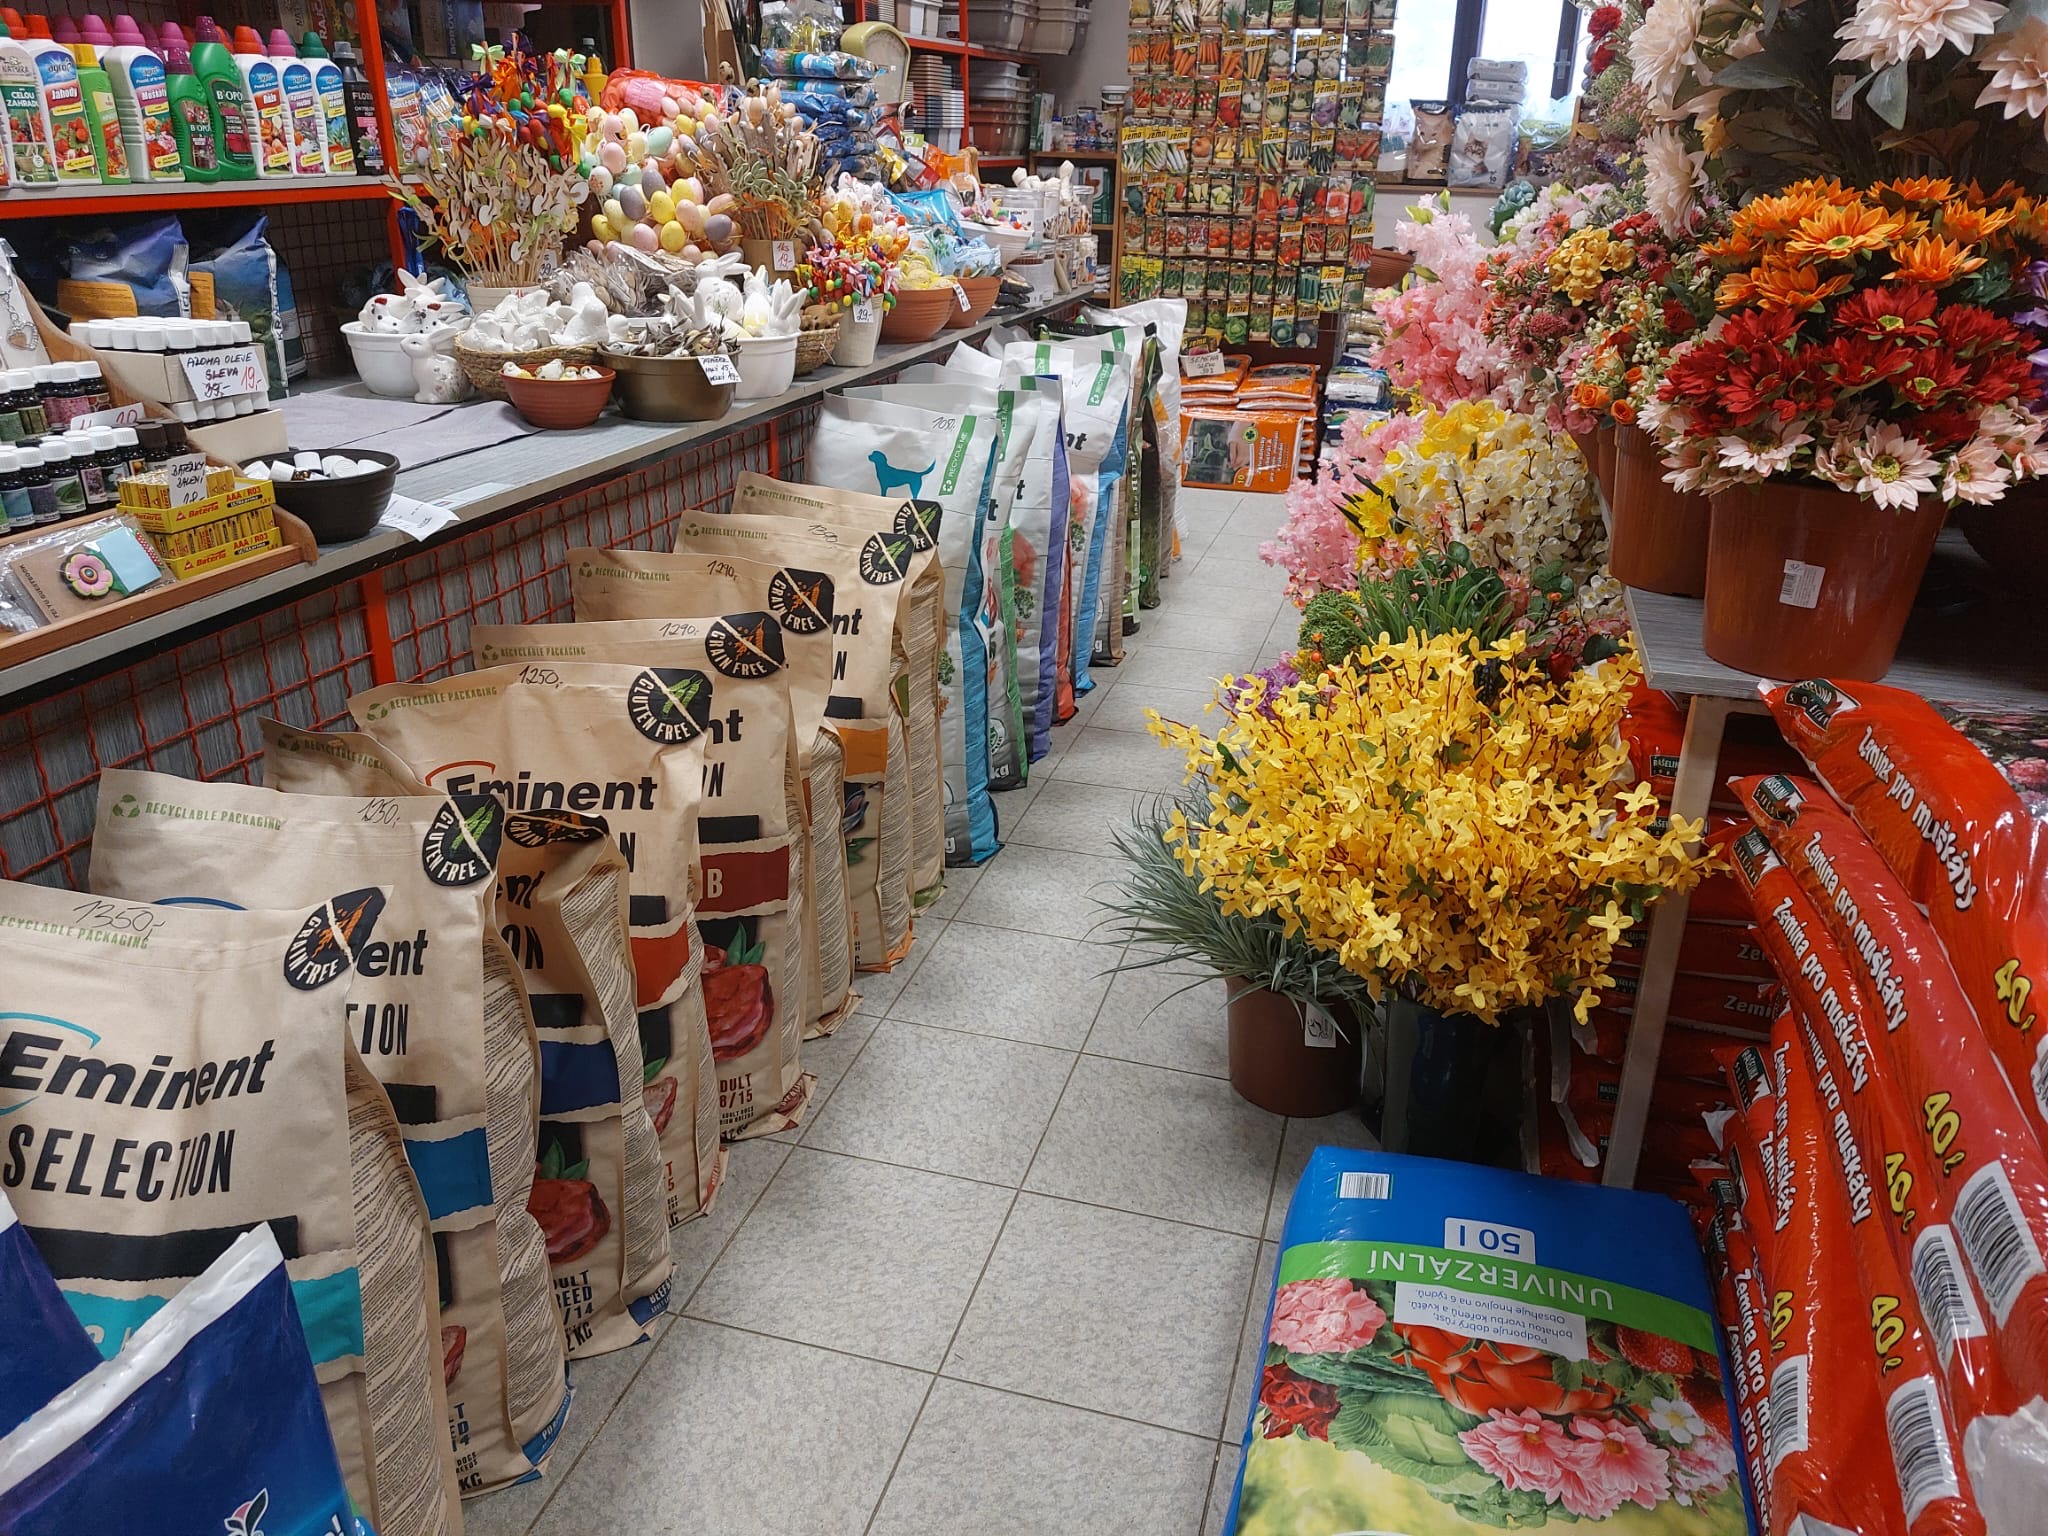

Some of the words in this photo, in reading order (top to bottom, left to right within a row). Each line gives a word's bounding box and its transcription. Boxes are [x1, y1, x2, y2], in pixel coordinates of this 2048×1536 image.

[205, 367, 239, 381] SLEVA
[226, 492, 242, 502] AAA
[247, 486, 261, 497] R03
[188, 502, 219, 518] Bateria
[233, 539, 249, 549] AAA
[862, 539, 880, 576] GLUTEN
[196, 550, 226, 567] Bateria
[870, 570, 894, 584] FREE
[769, 578, 787, 617] GRAIN
[785, 614, 816, 632] FREE
[708, 629, 729, 671] GRAIN
[732, 660, 768, 677] FREE
[389, 690, 446, 711] RECYCLABLE
[448, 685, 498, 703] PACKAGING
[631, 677, 655, 731] GLUTEN
[654, 721, 692, 742] FREE
[446, 771, 658, 811] Eminent
[145, 801, 218, 821] RECYCLABLE
[220, 808, 282, 831] PACKAGING
[422, 809, 453, 874] GLUTEN
[510, 819, 543, 846] GRAIN
[1886, 771, 1914, 811] pro
[1911, 799, 1978, 910] muškáty
[437, 861, 478, 883] FREE
[77, 927, 149, 950] PACKAGING
[287, 914, 322, 975] GRAIN
[1804, 831, 1840, 895] Zemina
[1834, 886, 1859, 928] pro
[1853, 919, 1909, 1033] muškáty
[299, 957, 340, 986] FREE
[1772, 896, 1811, 960] Zemina
[1801, 952, 1828, 992] pro
[1820, 985, 1870, 1094] muškáty
[1, 1031, 276, 1110] Eminent
[3, 1123, 236, 1202] SELECTION
[1818, 1076, 1841, 1112] pro
[1833, 1112, 1873, 1225] muškáty
[1479, 1227, 1522, 1255] 50
[1369, 1248, 1614, 1312] UNIVERZÁLNÍ
[1451, 1308, 1488, 1322] kořenů
[1459, 1298, 1472, 1306] na
[1475, 1300, 1513, 1314] hnojivo
[1735, 1267, 1758, 1348] Zemina
[1433, 1311, 1456, 1325] růst,
[1458, 1320, 1490, 1333] dobrý
[1490, 1316, 1526, 1329] tvorbu
[1516, 1308, 1566, 1324] Obsahuje
[1492, 1326, 1548, 1345] Podporuje
[1528, 1322, 1573, 1341] bohatou
